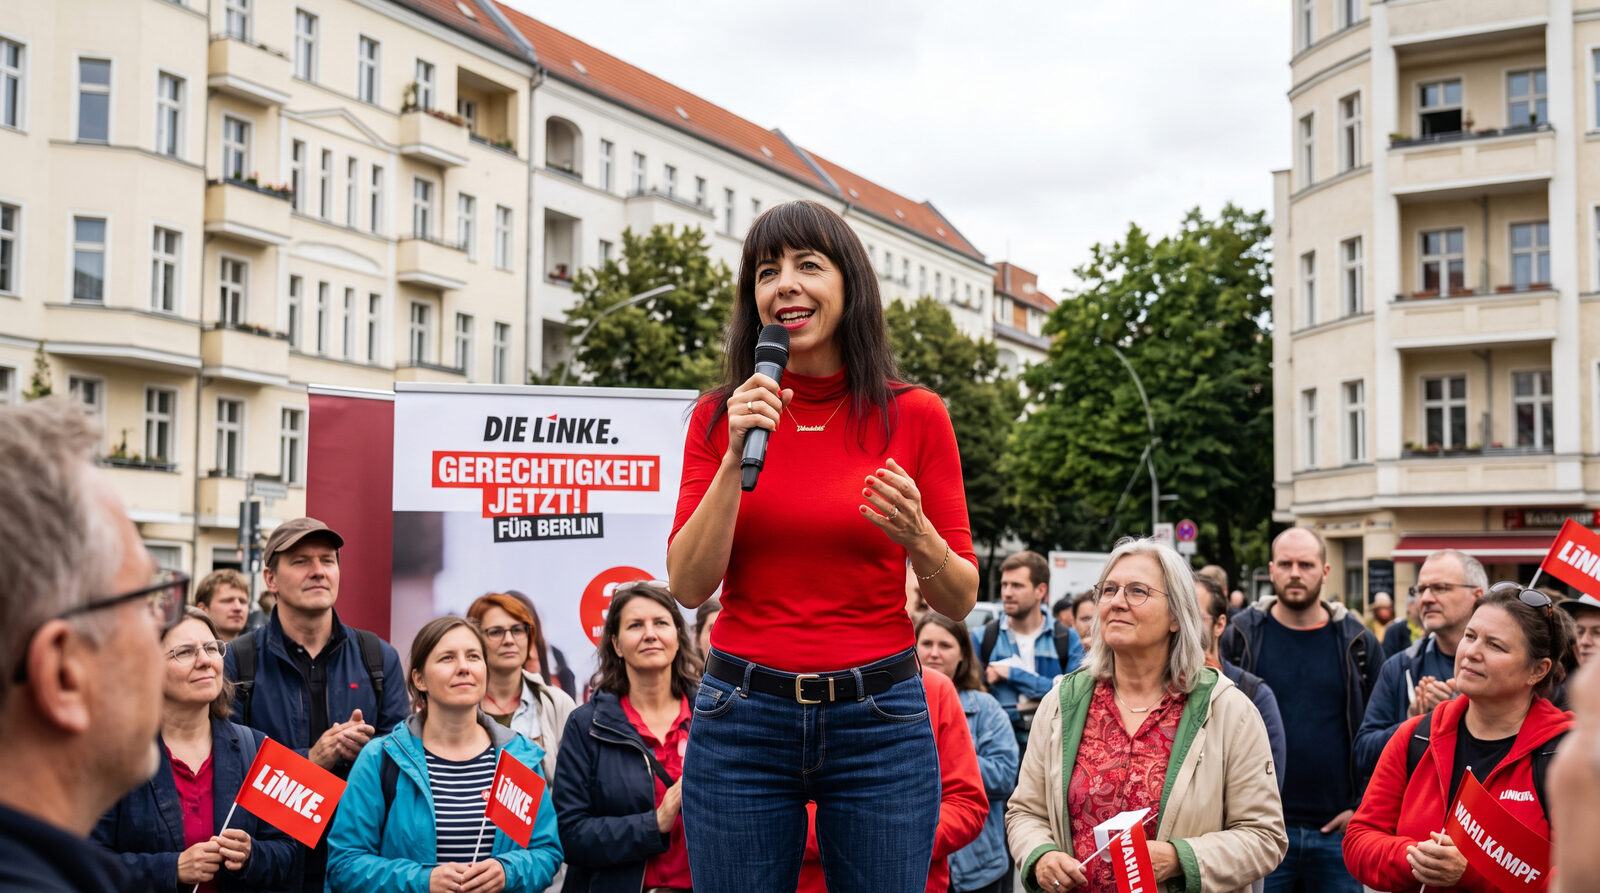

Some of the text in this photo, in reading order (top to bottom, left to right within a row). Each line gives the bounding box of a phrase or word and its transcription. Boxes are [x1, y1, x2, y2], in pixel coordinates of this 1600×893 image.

[483, 413, 619, 445] DIE LINKE.
[438, 456, 655, 487] GERECHTIGKEIT
[488, 487, 581, 514] JETZT!
[498, 516, 599, 539] FÜR BERLIN
[252, 763, 325, 824] LINKE.
[494, 773, 534, 826] LINKE.
[1119, 829, 1144, 893] WAHIL
[1454, 800, 1541, 884] WAHLKAMPF
